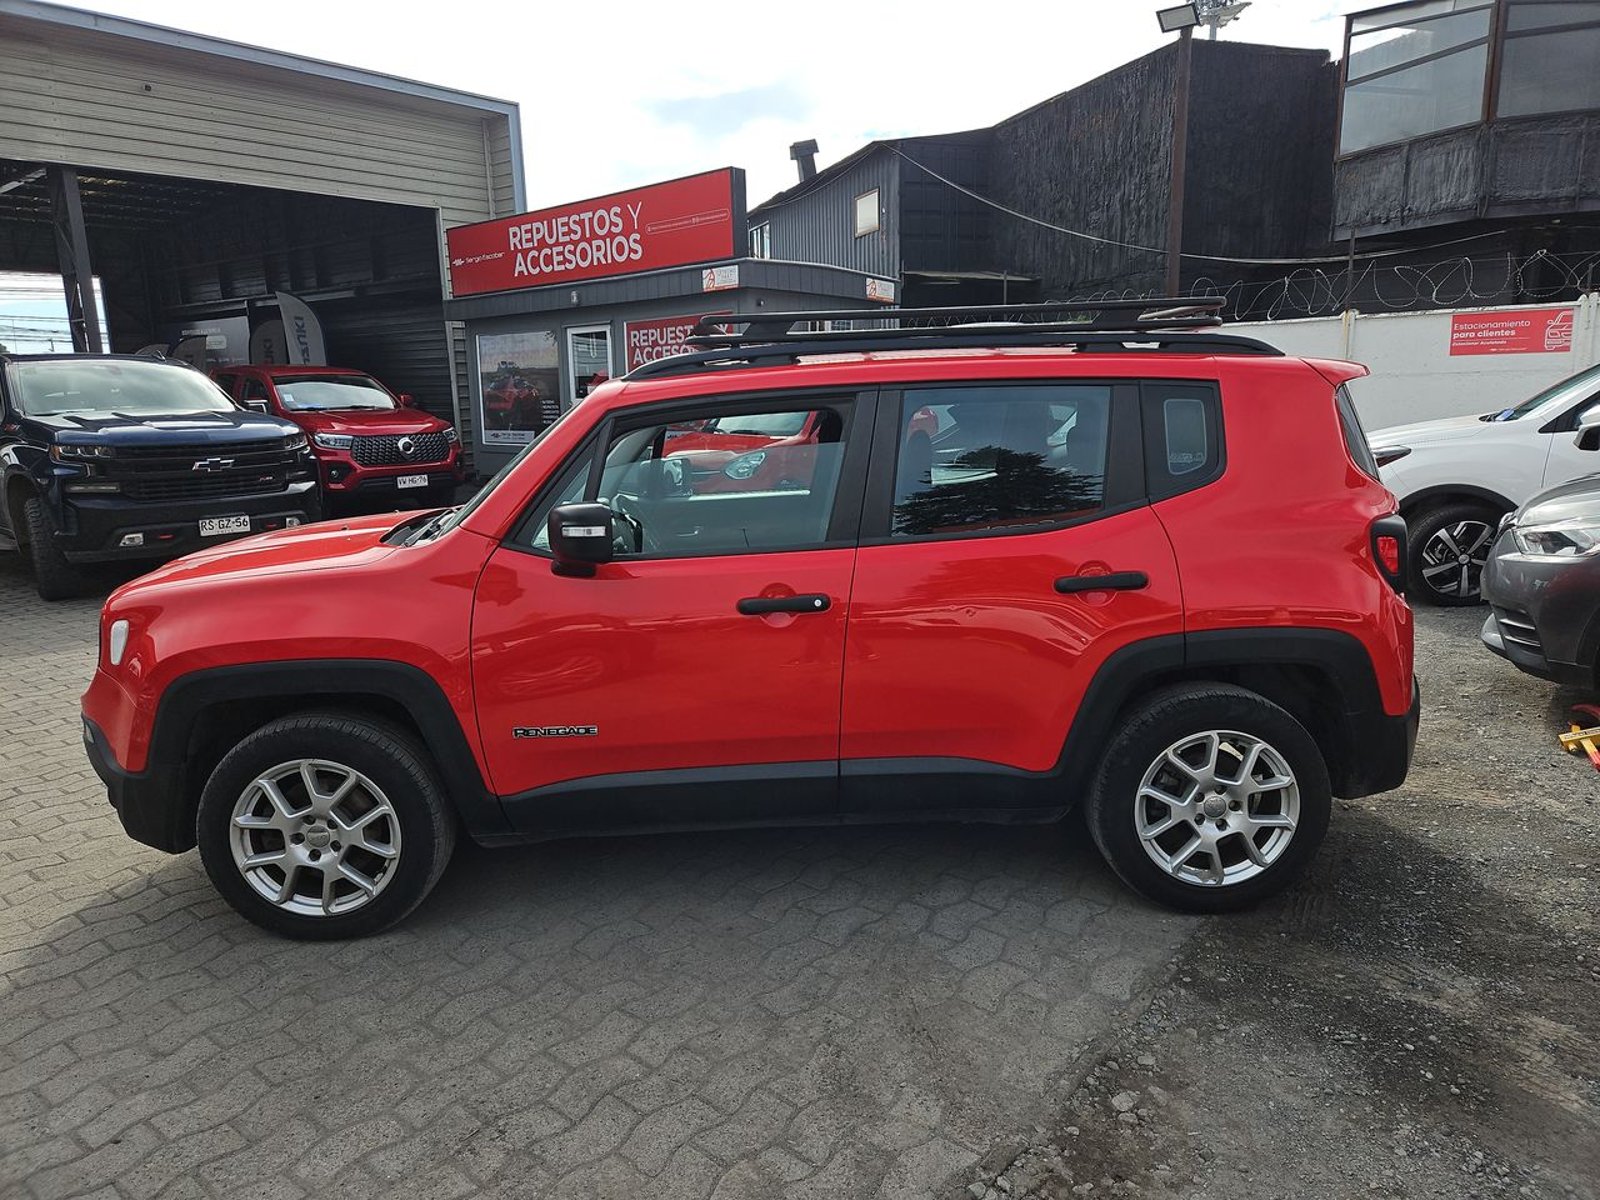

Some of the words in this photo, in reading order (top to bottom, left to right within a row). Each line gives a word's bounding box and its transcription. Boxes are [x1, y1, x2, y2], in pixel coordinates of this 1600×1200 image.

[509, 206, 623, 251] REPUESTOS
[627, 201, 642, 230] Y
[514, 233, 643, 277] ACCESORIOS
[1454, 320, 1530, 331] Estacionamiento
[630, 325, 694, 347] REPUEST
[1452, 332, 1476, 340] para
[1477, 330, 1515, 338] clientes
[512, 726, 598, 739] RENEGADE
